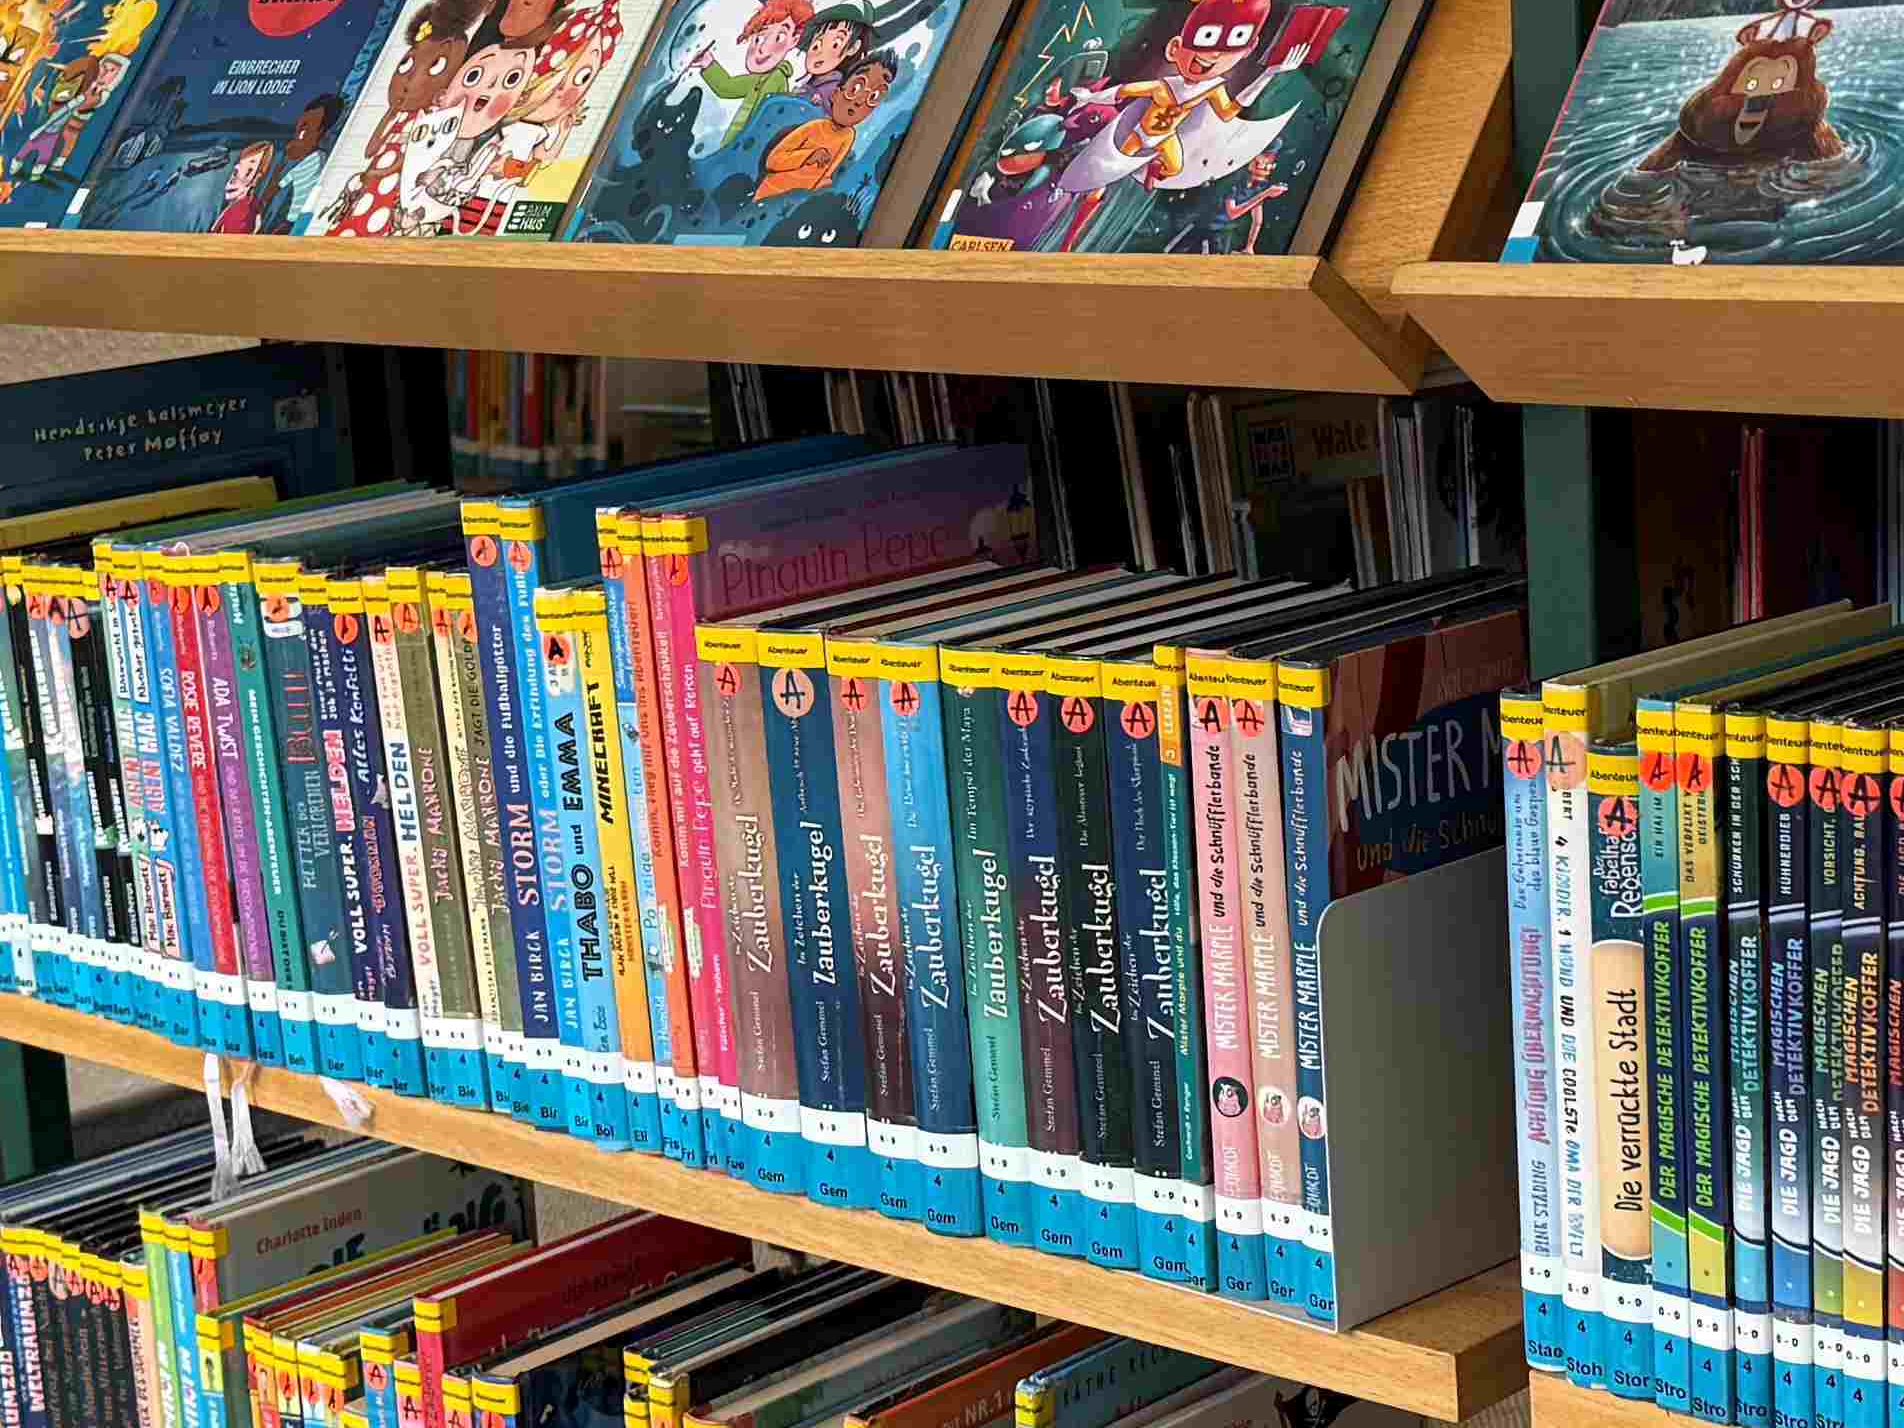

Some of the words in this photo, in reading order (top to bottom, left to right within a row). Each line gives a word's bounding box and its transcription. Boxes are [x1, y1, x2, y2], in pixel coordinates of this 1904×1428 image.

[228, 59, 301, 76] EINBRECHER
[256, 78, 297, 95] LODGE
[952, 240, 1009, 252] CARLSEN
[554, 712, 584, 811] EMMA
[585, 682, 615, 825] MINECRAFT
[1334, 718, 1472, 833] MISTER
[505, 802, 540, 906] STORM
[573, 824, 584, 854] und
[570, 863, 603, 982] THABO
[799, 821, 837, 986] Zauberkugel
[1295, 942, 1318, 1009] MARPLE
[1653, 921, 1675, 1067] DETEKTIVKOFFER
[1297, 1010, 1320, 1071] MISTER
[1608, 988, 1639, 1053] Stadt
[1615, 1062, 1641, 1172] verrückte
[1657, 1073, 1675, 1159] MAGISCHE
[1615, 1181, 1643, 1213] Die
[1658, 1165, 1676, 1201] DER
